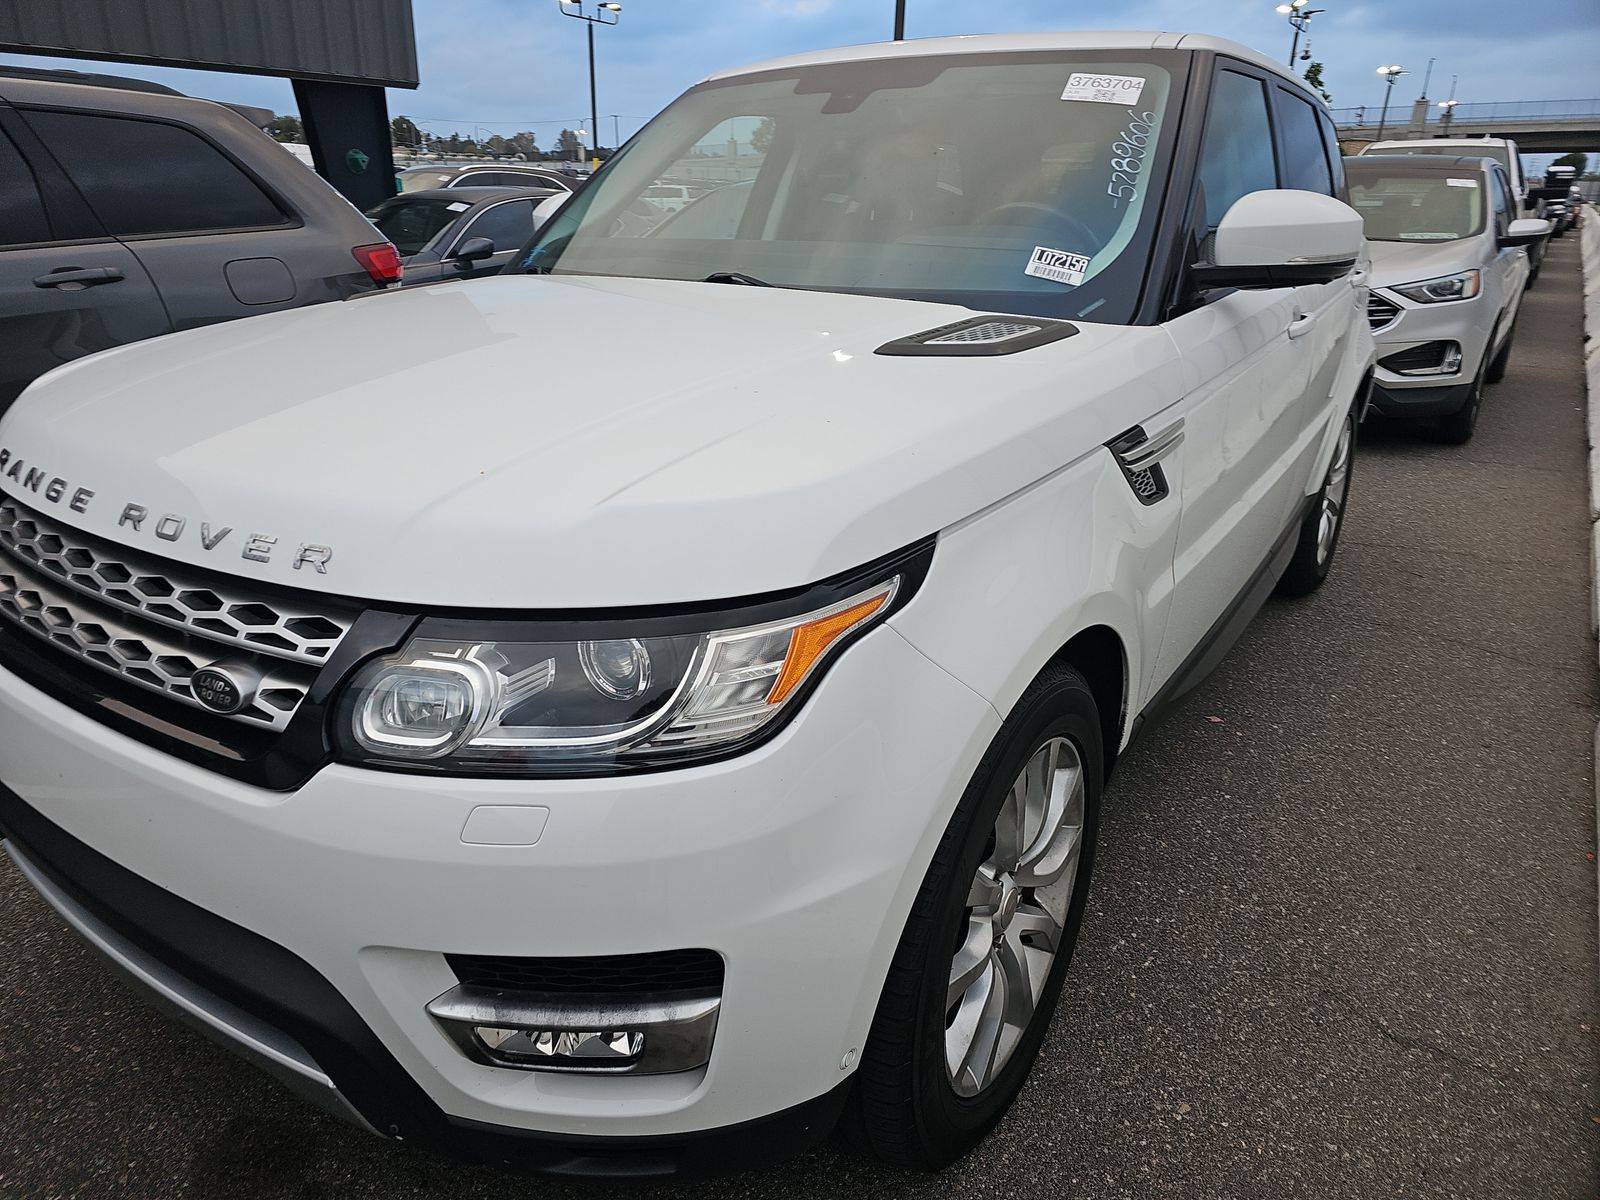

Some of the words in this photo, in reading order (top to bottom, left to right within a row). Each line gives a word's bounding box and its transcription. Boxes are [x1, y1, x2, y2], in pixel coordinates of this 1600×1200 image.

[1070, 76, 1143, 92] 3763704
[1033, 249, 1090, 273] L07215A
[0, 448, 96, 514] RANGE
[117, 502, 334, 574] ROVER
[201, 687, 232, 706] ROVER
